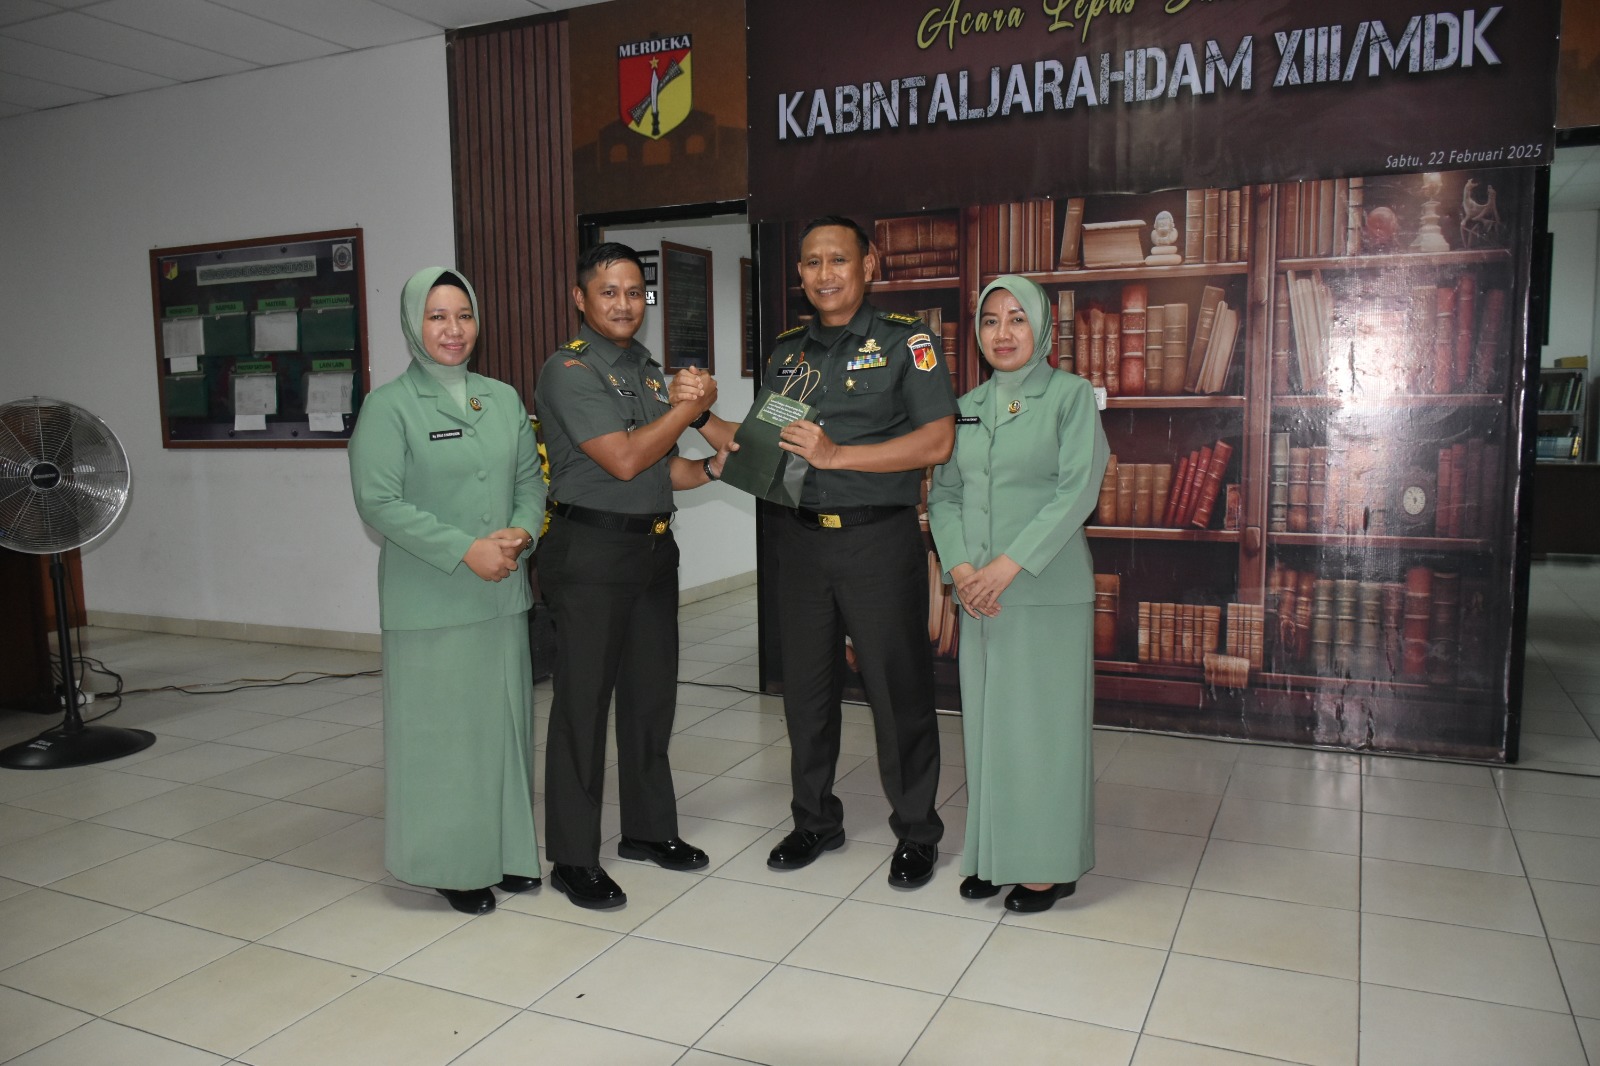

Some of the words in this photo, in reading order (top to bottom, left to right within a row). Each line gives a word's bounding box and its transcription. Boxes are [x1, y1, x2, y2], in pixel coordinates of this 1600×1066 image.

[916, 0, 1024, 50] Acara
[618, 35, 691, 58] MERDEKA
[778, 35, 1253, 141] KABINTALJARAHDAM
[1272, 6, 1503, 88] XIII/MDK
[1428, 151, 1445, 165] 22
[1448, 147, 1503, 164] Februari
[1507, 143, 1543, 160] 2025
